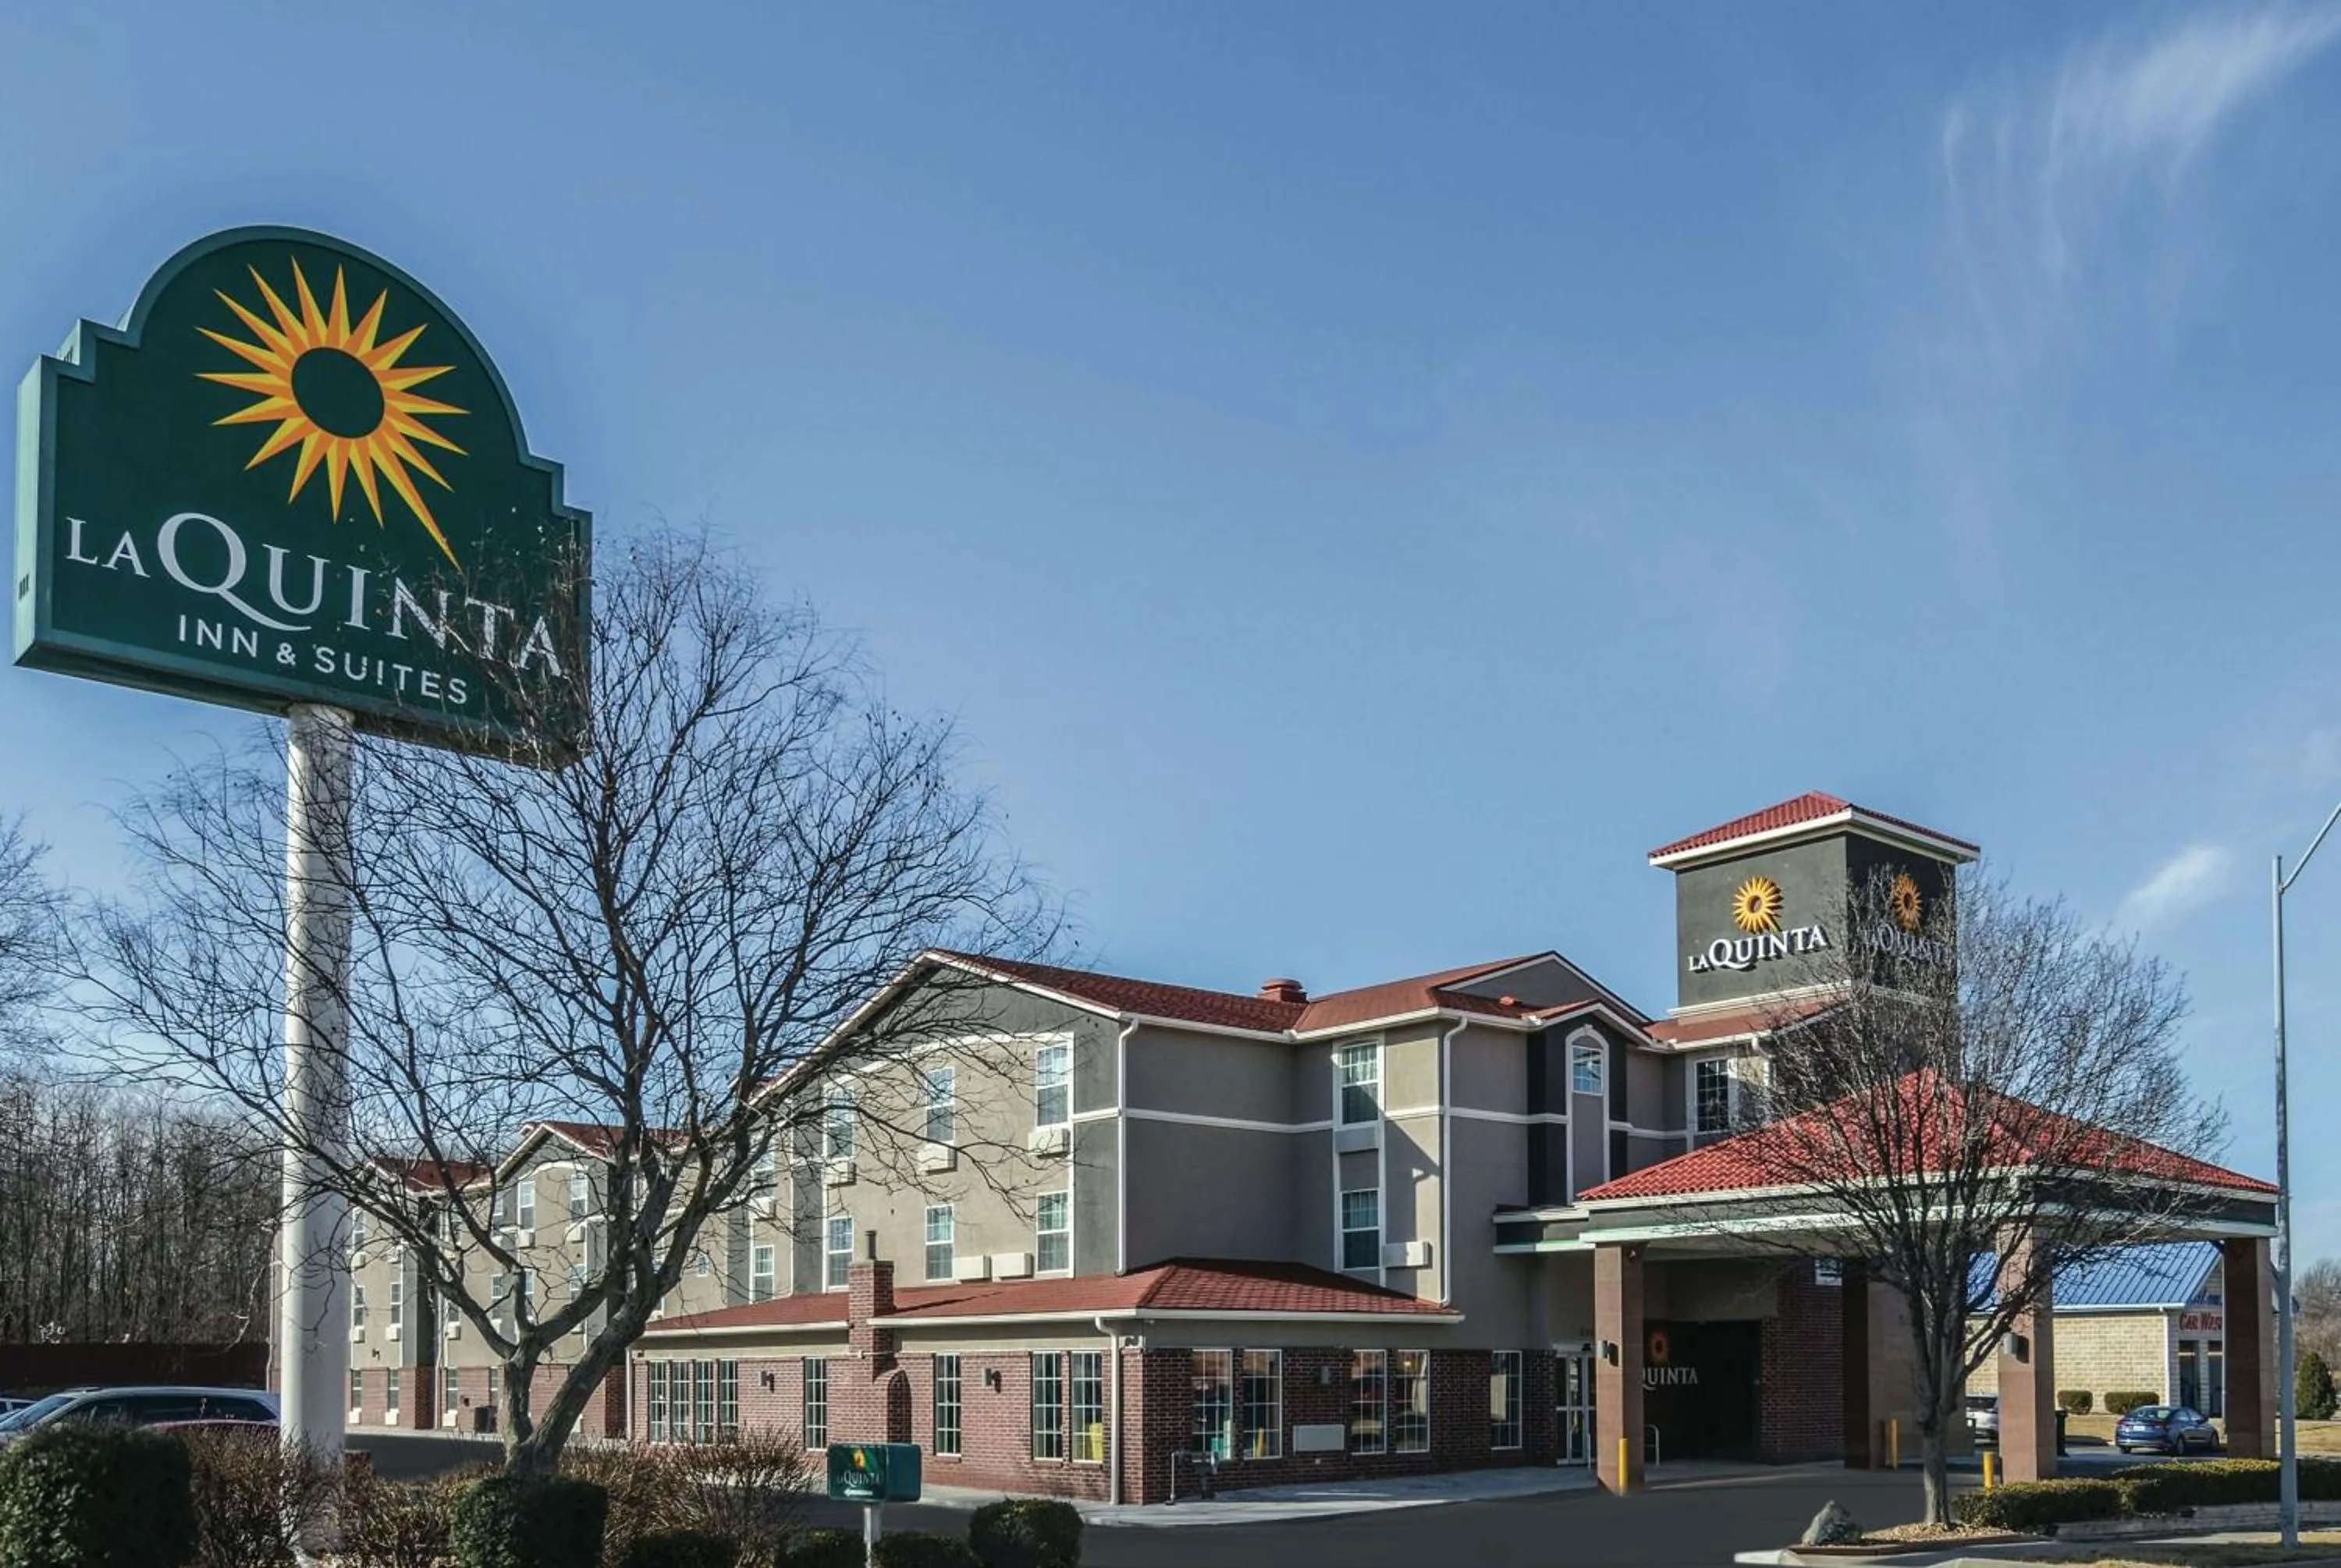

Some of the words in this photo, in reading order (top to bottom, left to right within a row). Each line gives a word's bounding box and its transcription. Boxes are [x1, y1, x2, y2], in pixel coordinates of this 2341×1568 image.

[66, 516, 150, 578] LA
[157, 513, 567, 677] QUINTA
[179, 614, 258, 658] INN
[275, 642, 297, 665] &
[314, 646, 468, 704] SUITES
[1688, 955, 1710, 971] LA
[1708, 924, 1828, 969] QUINTA
